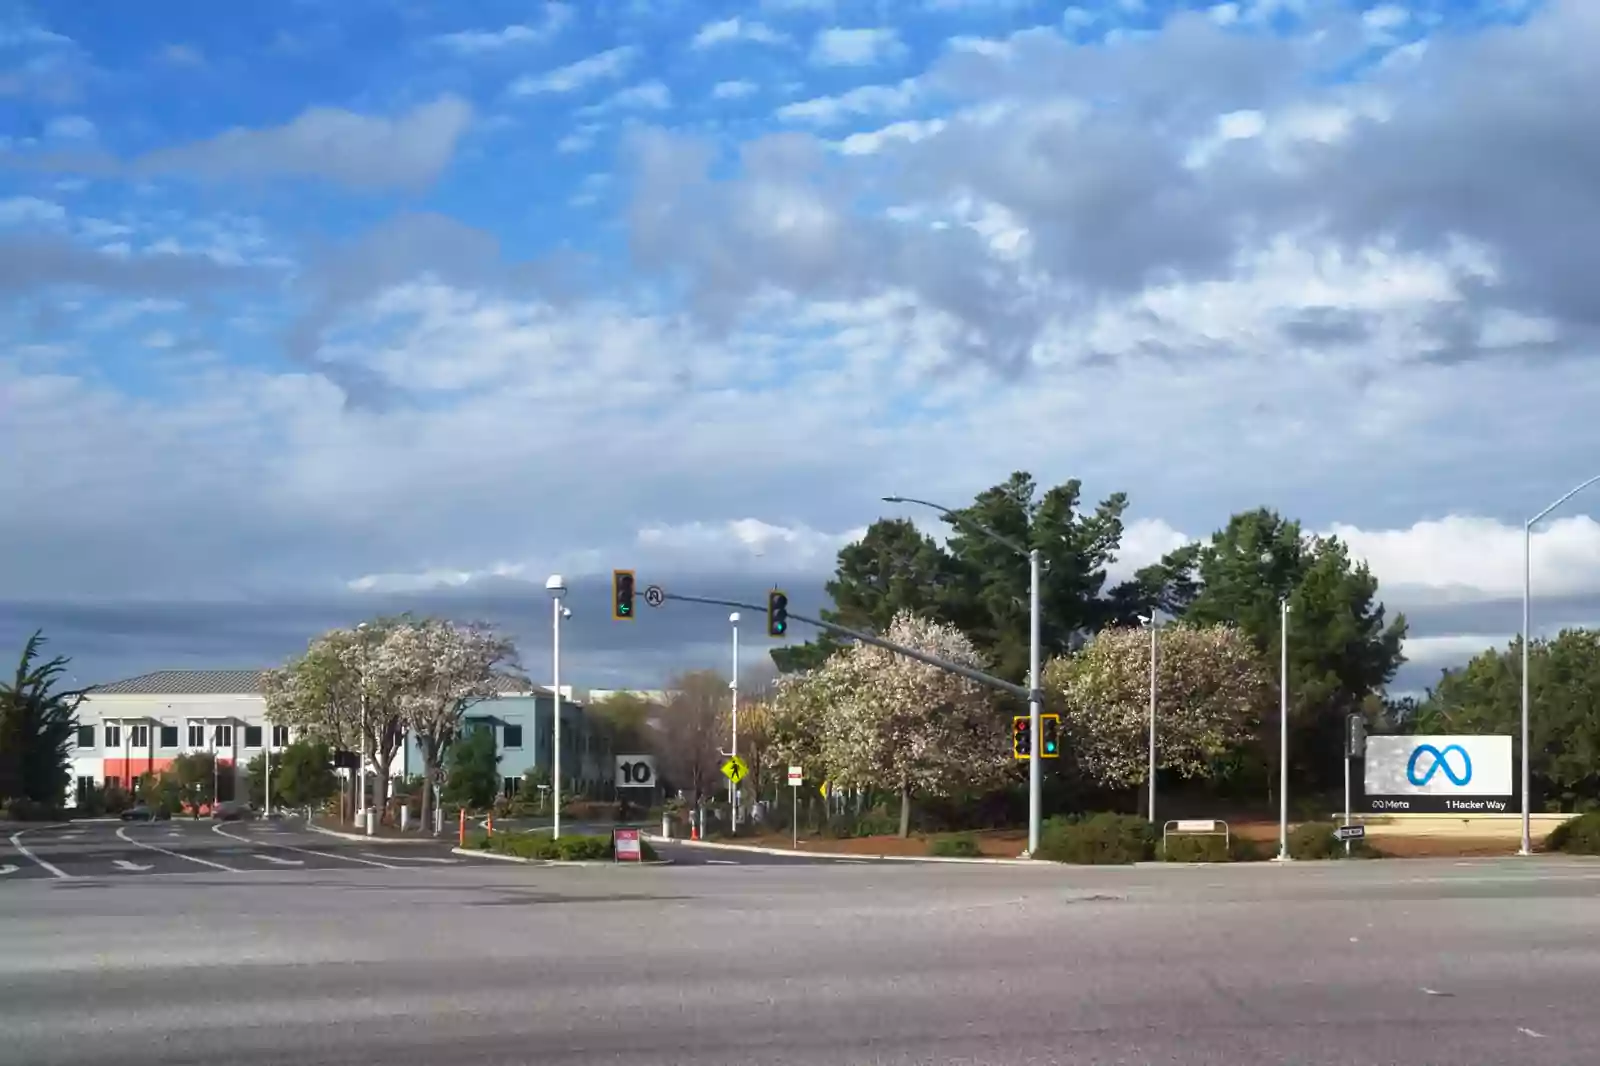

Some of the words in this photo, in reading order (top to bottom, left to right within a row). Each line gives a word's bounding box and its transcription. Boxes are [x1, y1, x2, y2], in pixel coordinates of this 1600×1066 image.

[620, 761, 651, 783] 10
[1385, 800, 1409, 809] Meta
[1445, 800, 1451, 809] 1
[1452, 800, 1484, 809] Hacker
[1486, 800, 1506, 811] Way
